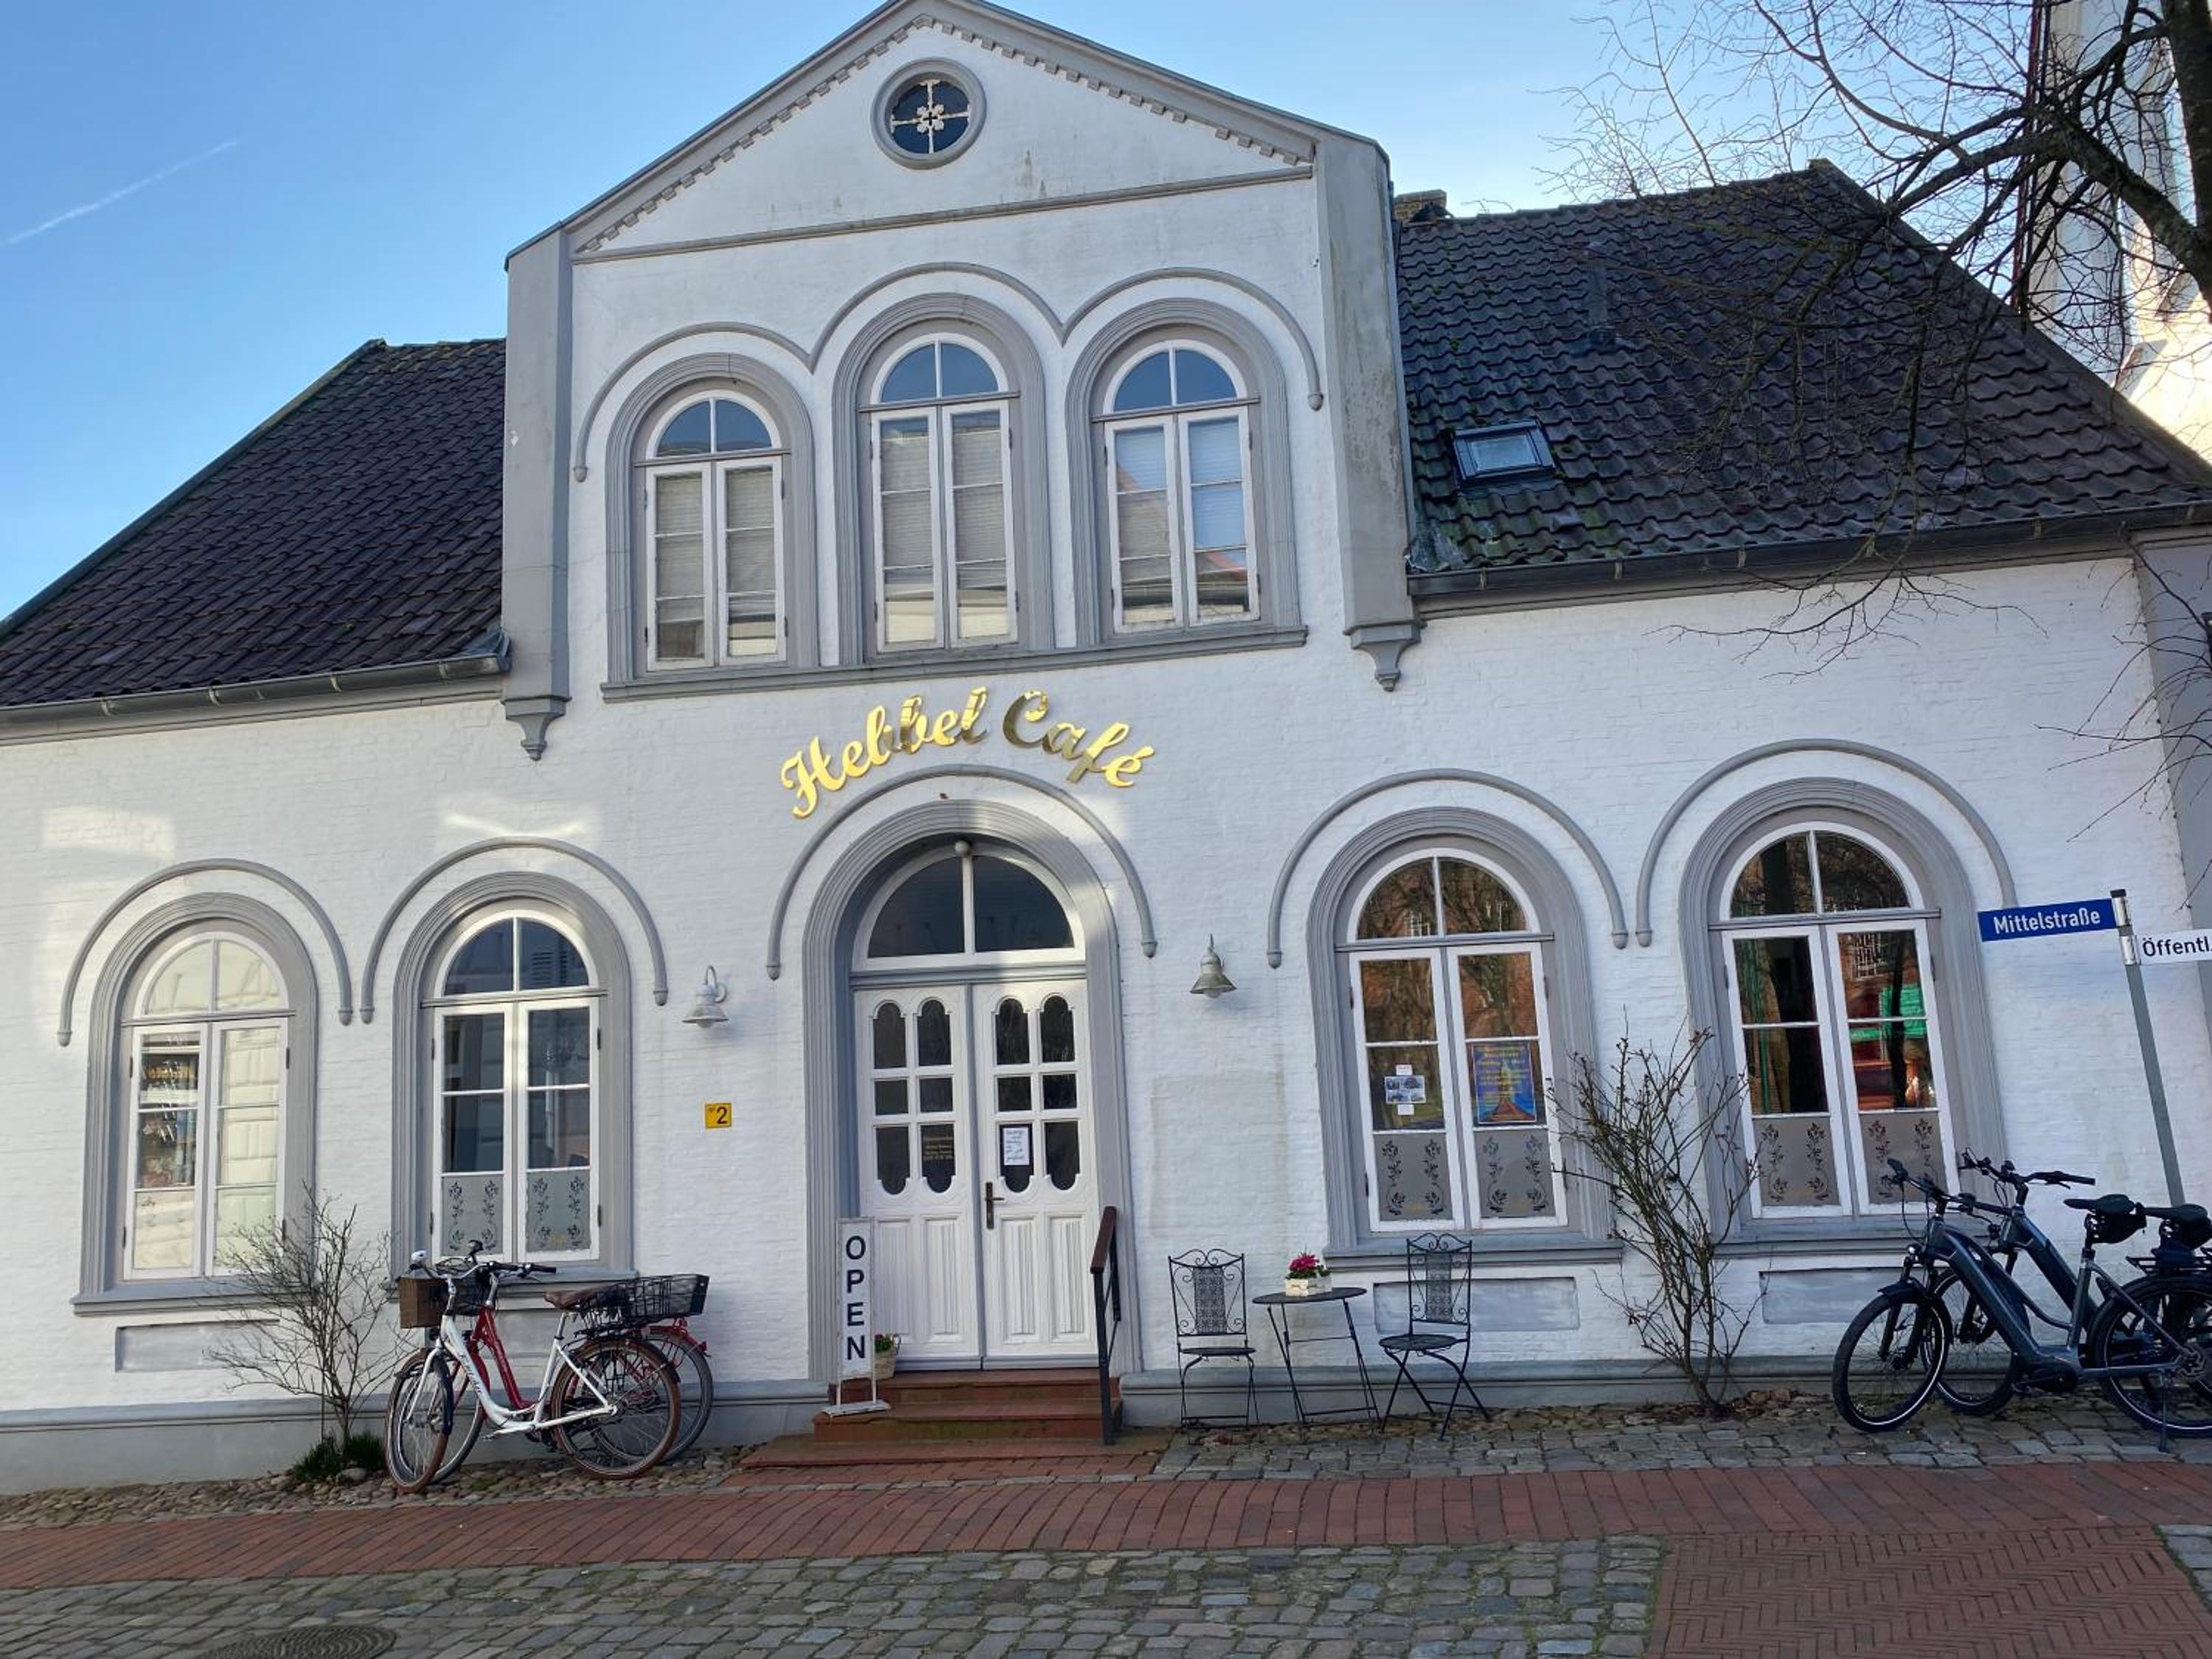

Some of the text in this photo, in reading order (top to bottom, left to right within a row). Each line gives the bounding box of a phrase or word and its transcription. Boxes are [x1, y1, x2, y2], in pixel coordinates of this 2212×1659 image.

[780, 686, 1155, 818] Hebbel Café
[1993, 908, 2101, 934] Mittelstraße
[717, 1107, 727, 1124] 2
[846, 1235, 866, 1360] OPEN
